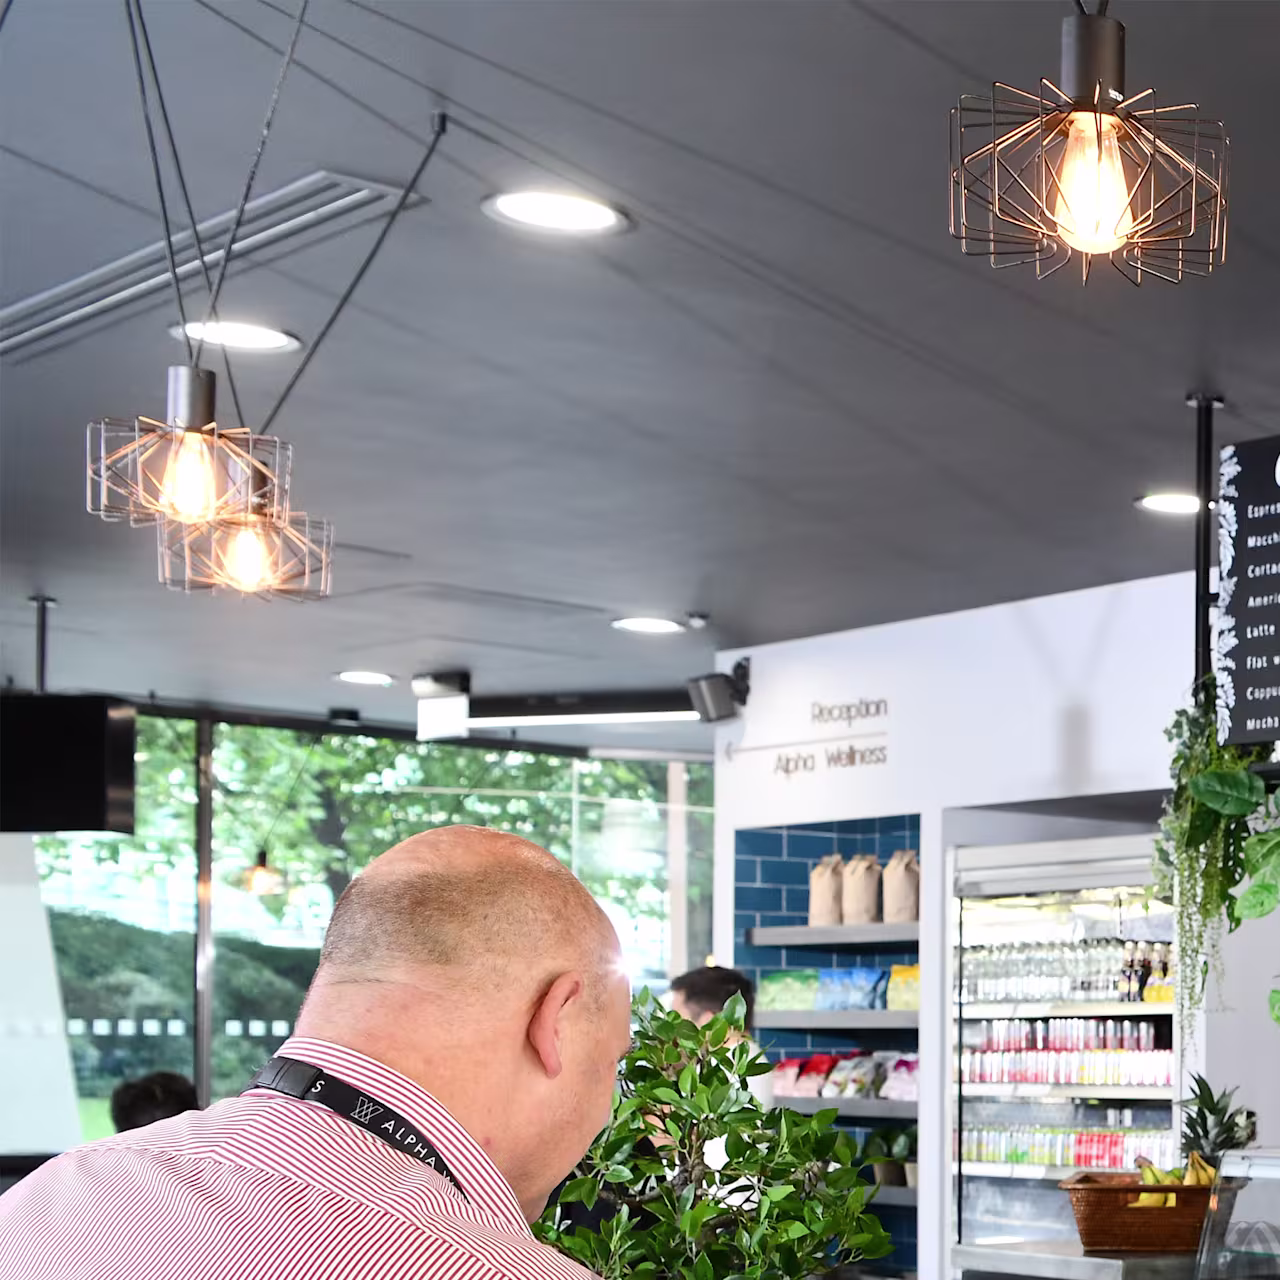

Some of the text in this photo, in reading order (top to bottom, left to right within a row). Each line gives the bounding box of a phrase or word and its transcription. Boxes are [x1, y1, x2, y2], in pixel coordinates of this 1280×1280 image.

[1247, 625, 1275, 638] Latte
[1247, 656, 1267, 670] Flat
[812, 699, 887, 728] Reception
[1247, 716, 1279, 730] Mocha
[774, 745, 887, 780] Alpha Wellness
[381, 1120, 436, 1170] ALPHA
